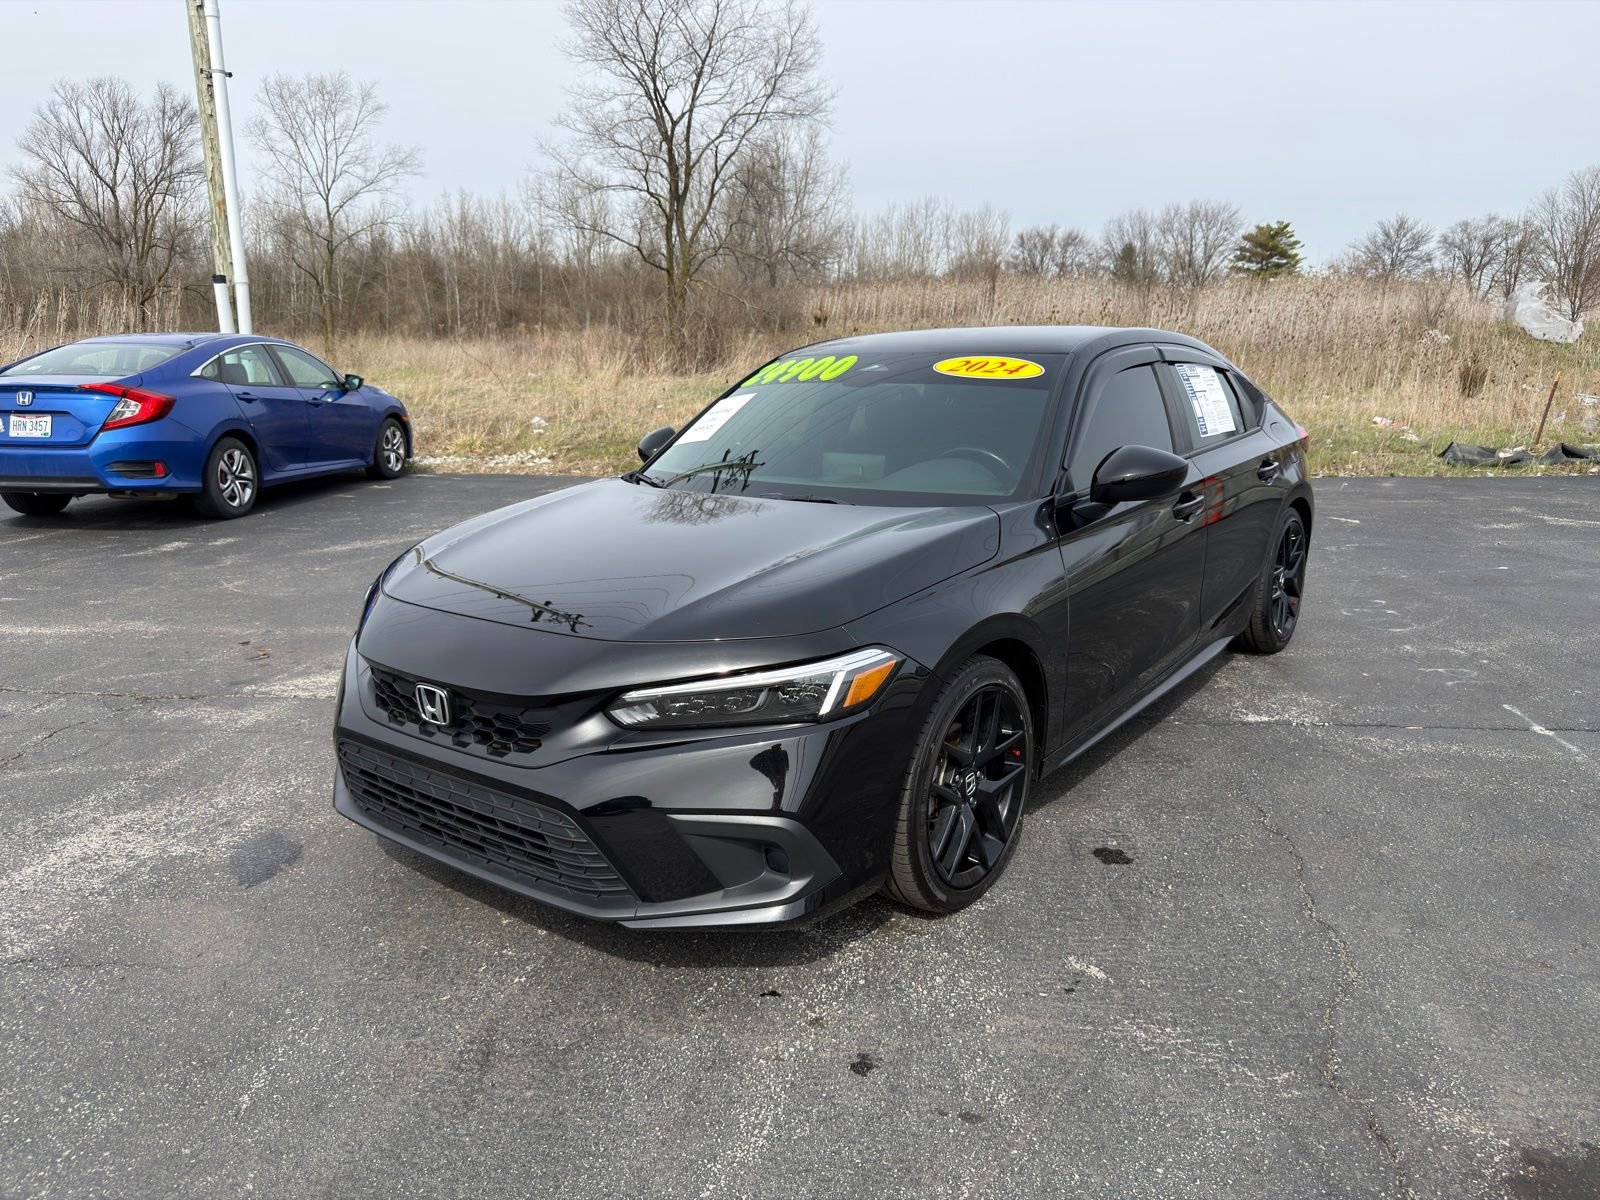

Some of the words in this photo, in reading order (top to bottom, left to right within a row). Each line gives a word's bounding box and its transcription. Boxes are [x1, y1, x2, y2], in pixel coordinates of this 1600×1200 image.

[946, 360, 1029, 375] 2024
[12, 420, 27, 432] HRN
[28, 420, 48, 432] 3457
